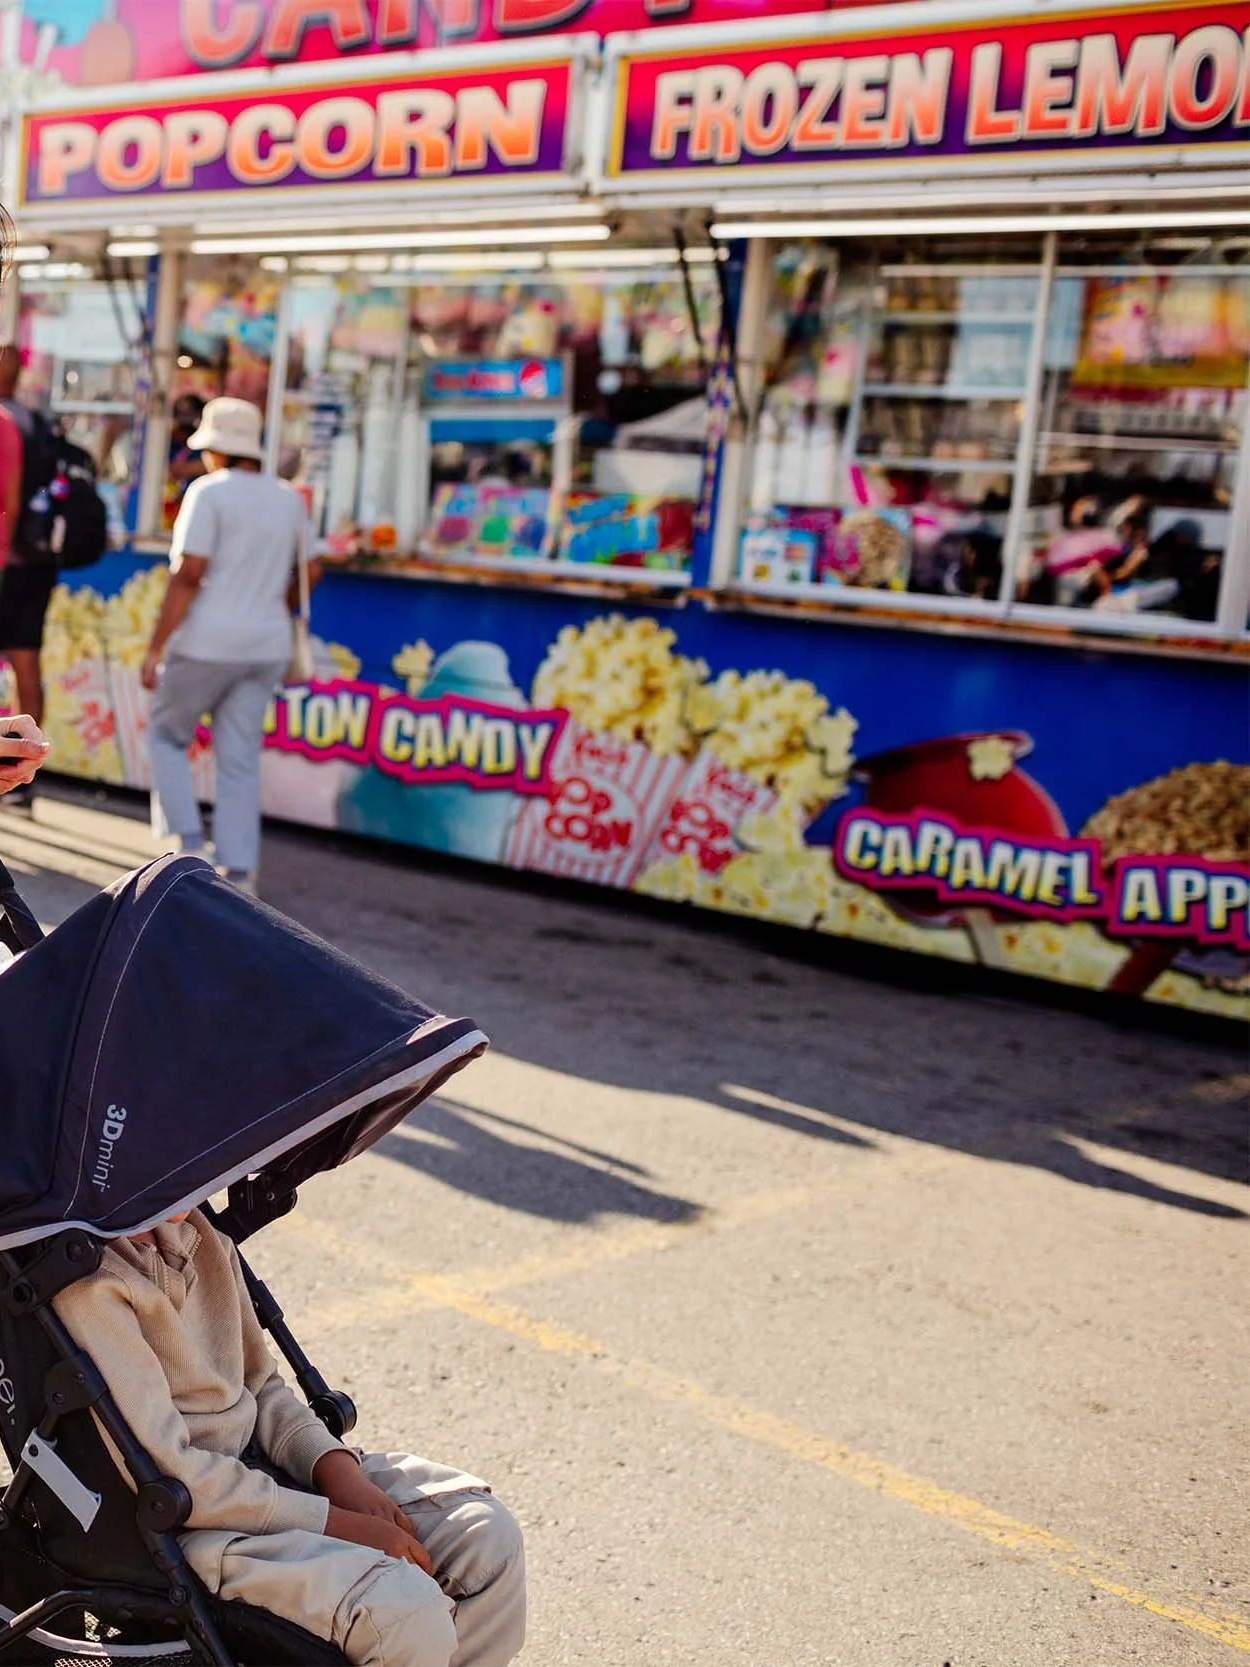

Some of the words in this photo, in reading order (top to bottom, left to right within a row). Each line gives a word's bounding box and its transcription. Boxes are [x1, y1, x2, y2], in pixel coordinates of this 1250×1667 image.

[39, 79, 547, 195] POPCORN
[653, 47, 953, 164] FROZEN
[965, 24, 1250, 146] LEMO
[379, 704, 554, 781] CANDY
[843, 818, 1098, 905] CARAMEL
[1121, 866, 1250, 932] APP
